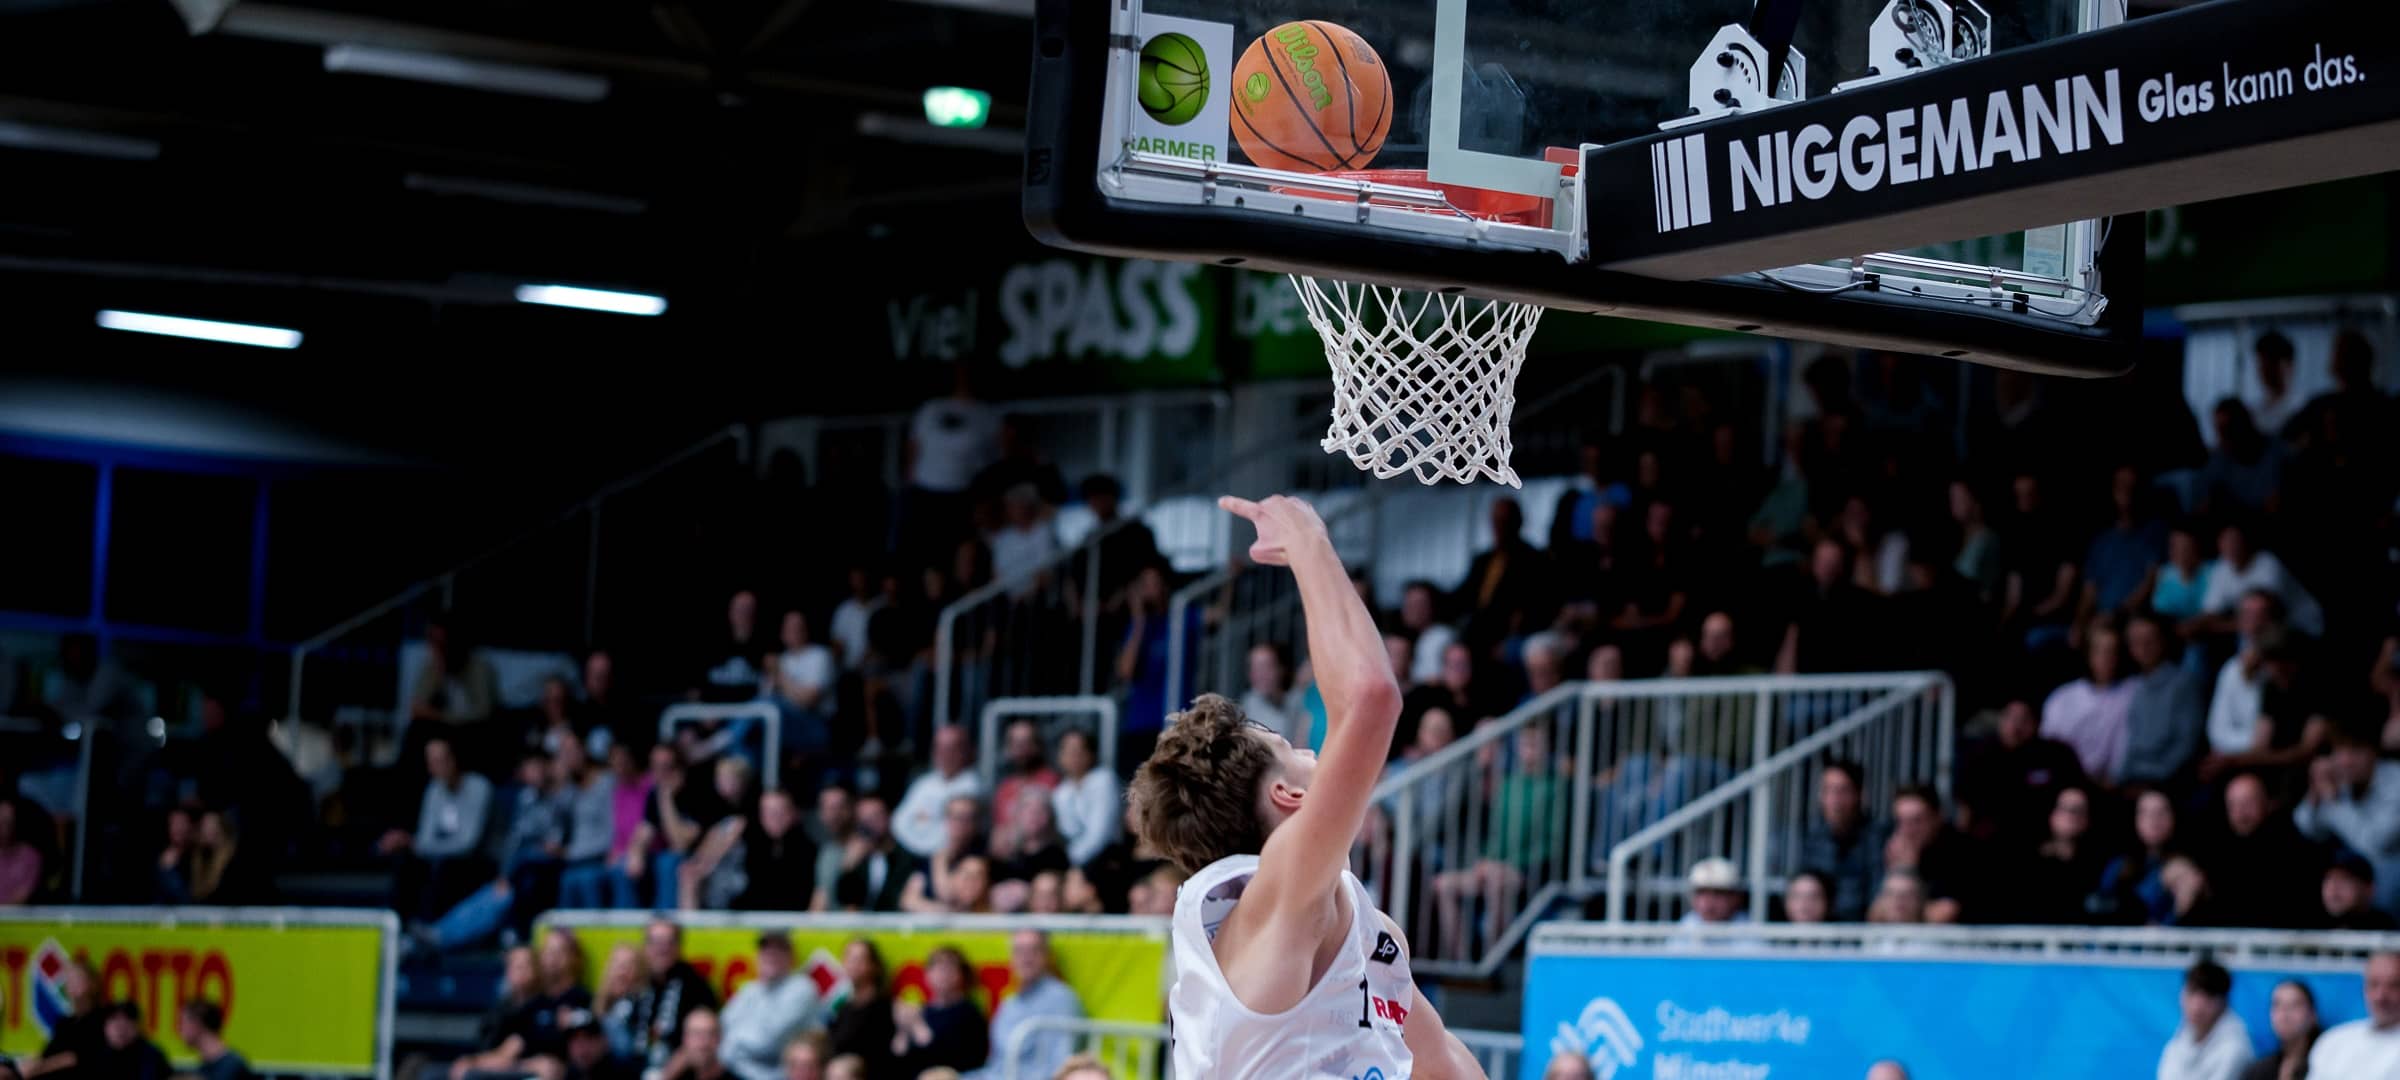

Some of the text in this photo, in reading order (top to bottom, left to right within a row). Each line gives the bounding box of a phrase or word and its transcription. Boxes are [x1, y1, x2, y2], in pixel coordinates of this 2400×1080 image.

[1274, 23, 1333, 113] Wilson
[1127, 135, 1216, 161] ARMER
[1729, 42, 2366, 211] NIGGEMANN Glas kann das.
[886, 288, 980, 363] Viel
[1000, 256, 1201, 368] SPASS
[1654, 998, 1813, 1045] Stadtwerke
